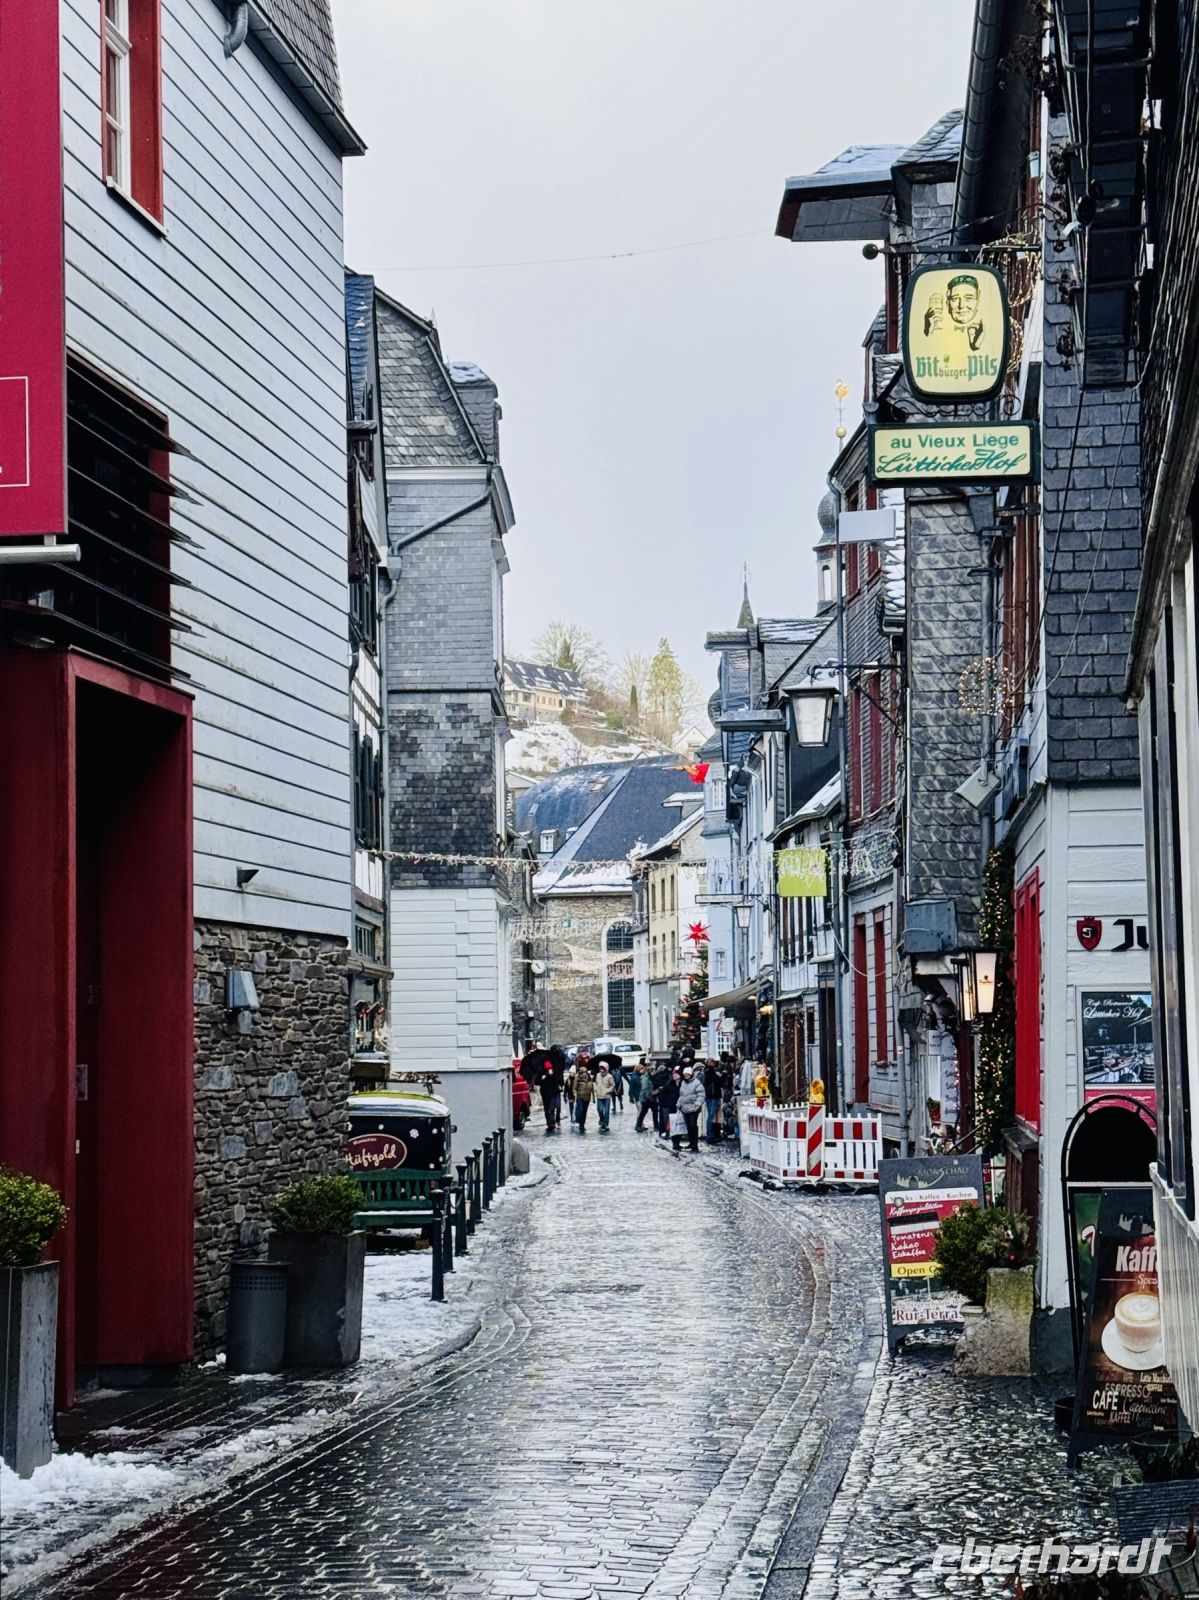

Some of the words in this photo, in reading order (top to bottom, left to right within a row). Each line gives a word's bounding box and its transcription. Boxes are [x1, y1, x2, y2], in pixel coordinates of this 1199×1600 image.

[968, 354, 998, 382] Pils
[890, 437, 912, 448] au
[917, 434, 965, 448] Vieux
[891, 1241, 920, 1252] Kakao
[897, 1266, 926, 1277] Open
